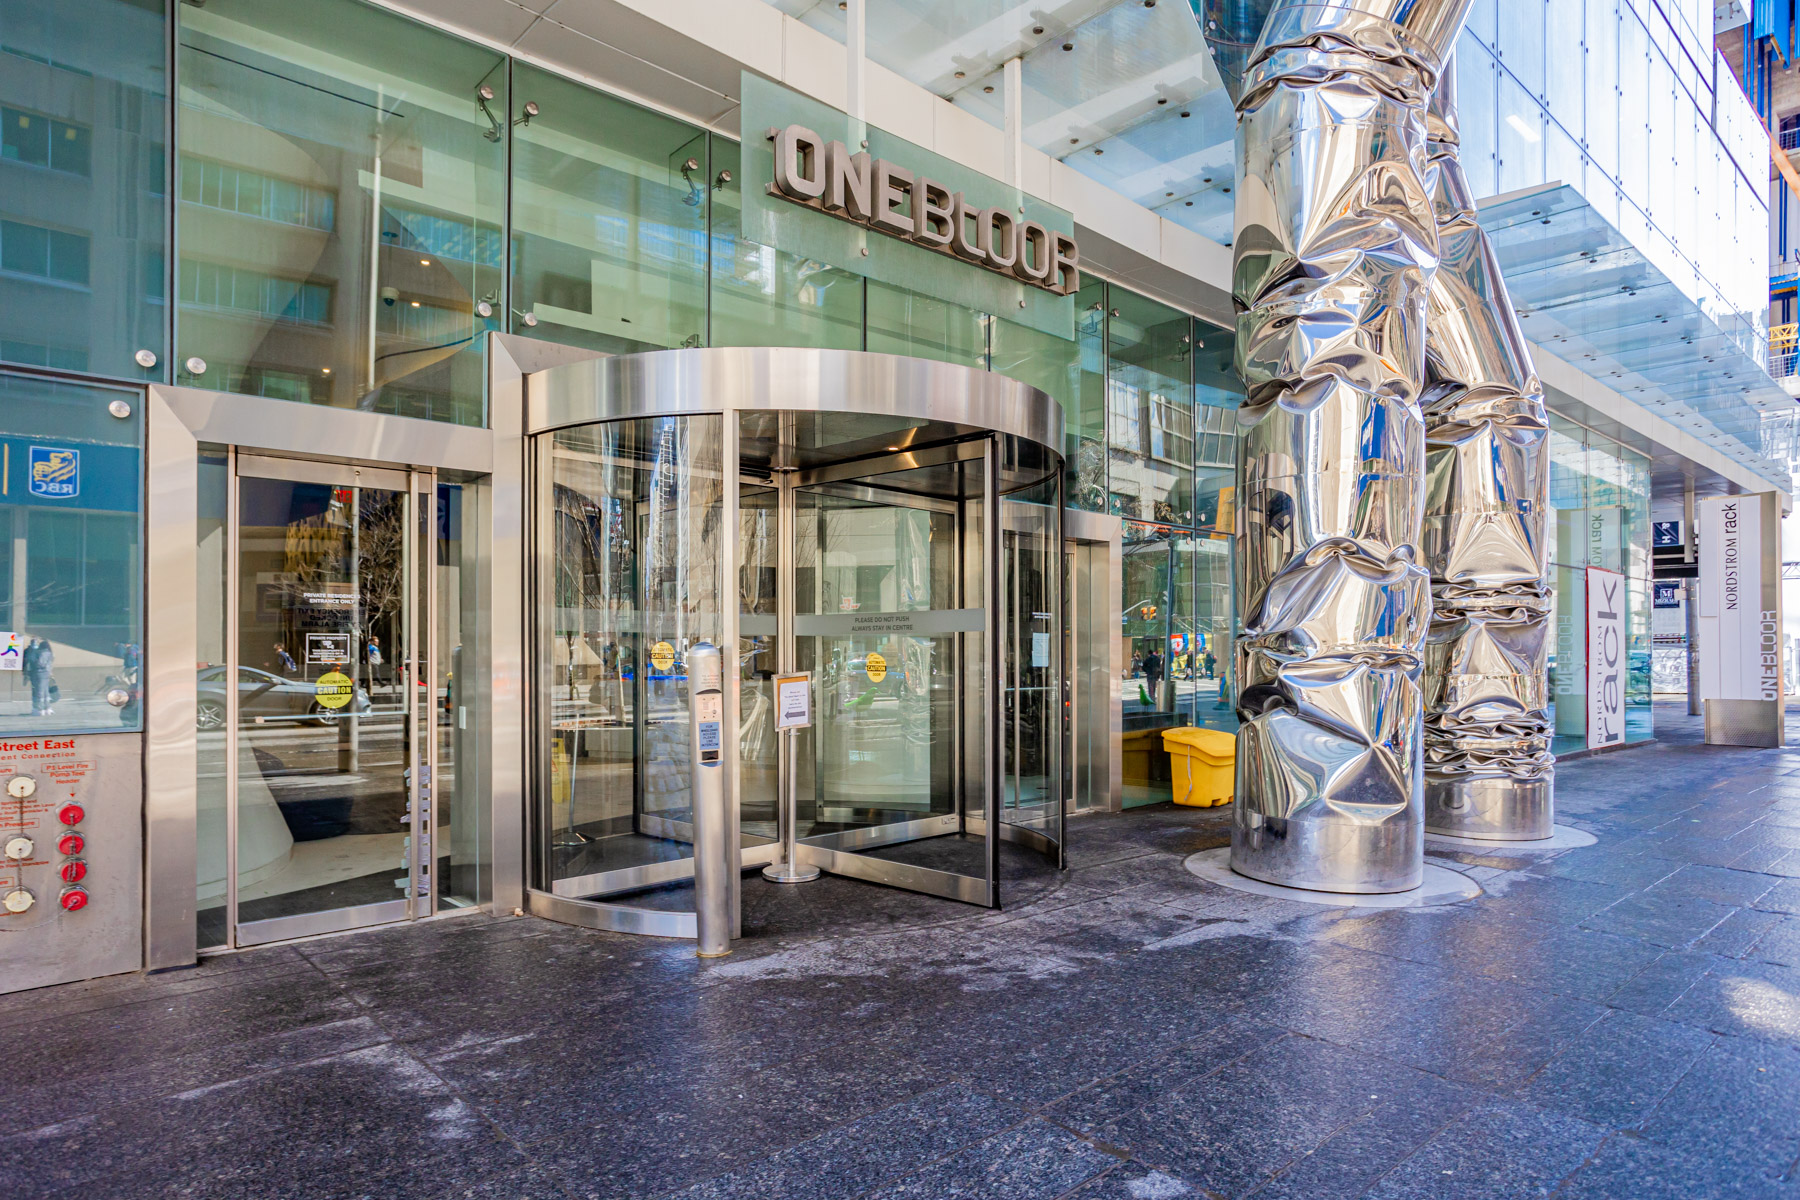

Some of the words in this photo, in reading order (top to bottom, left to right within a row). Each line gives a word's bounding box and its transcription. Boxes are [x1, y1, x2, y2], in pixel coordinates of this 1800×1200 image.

[773, 124, 1080, 295] ONEBLOOR
[1722, 503, 1737, 534] rack
[1725, 538, 1738, 610] NORDSTROM
[317, 686, 352, 694] CAUTION
[1597, 577, 1618, 742] rack
[1760, 610, 1777, 701] ONEBLOOR
[44, 739, 75, 749] East
